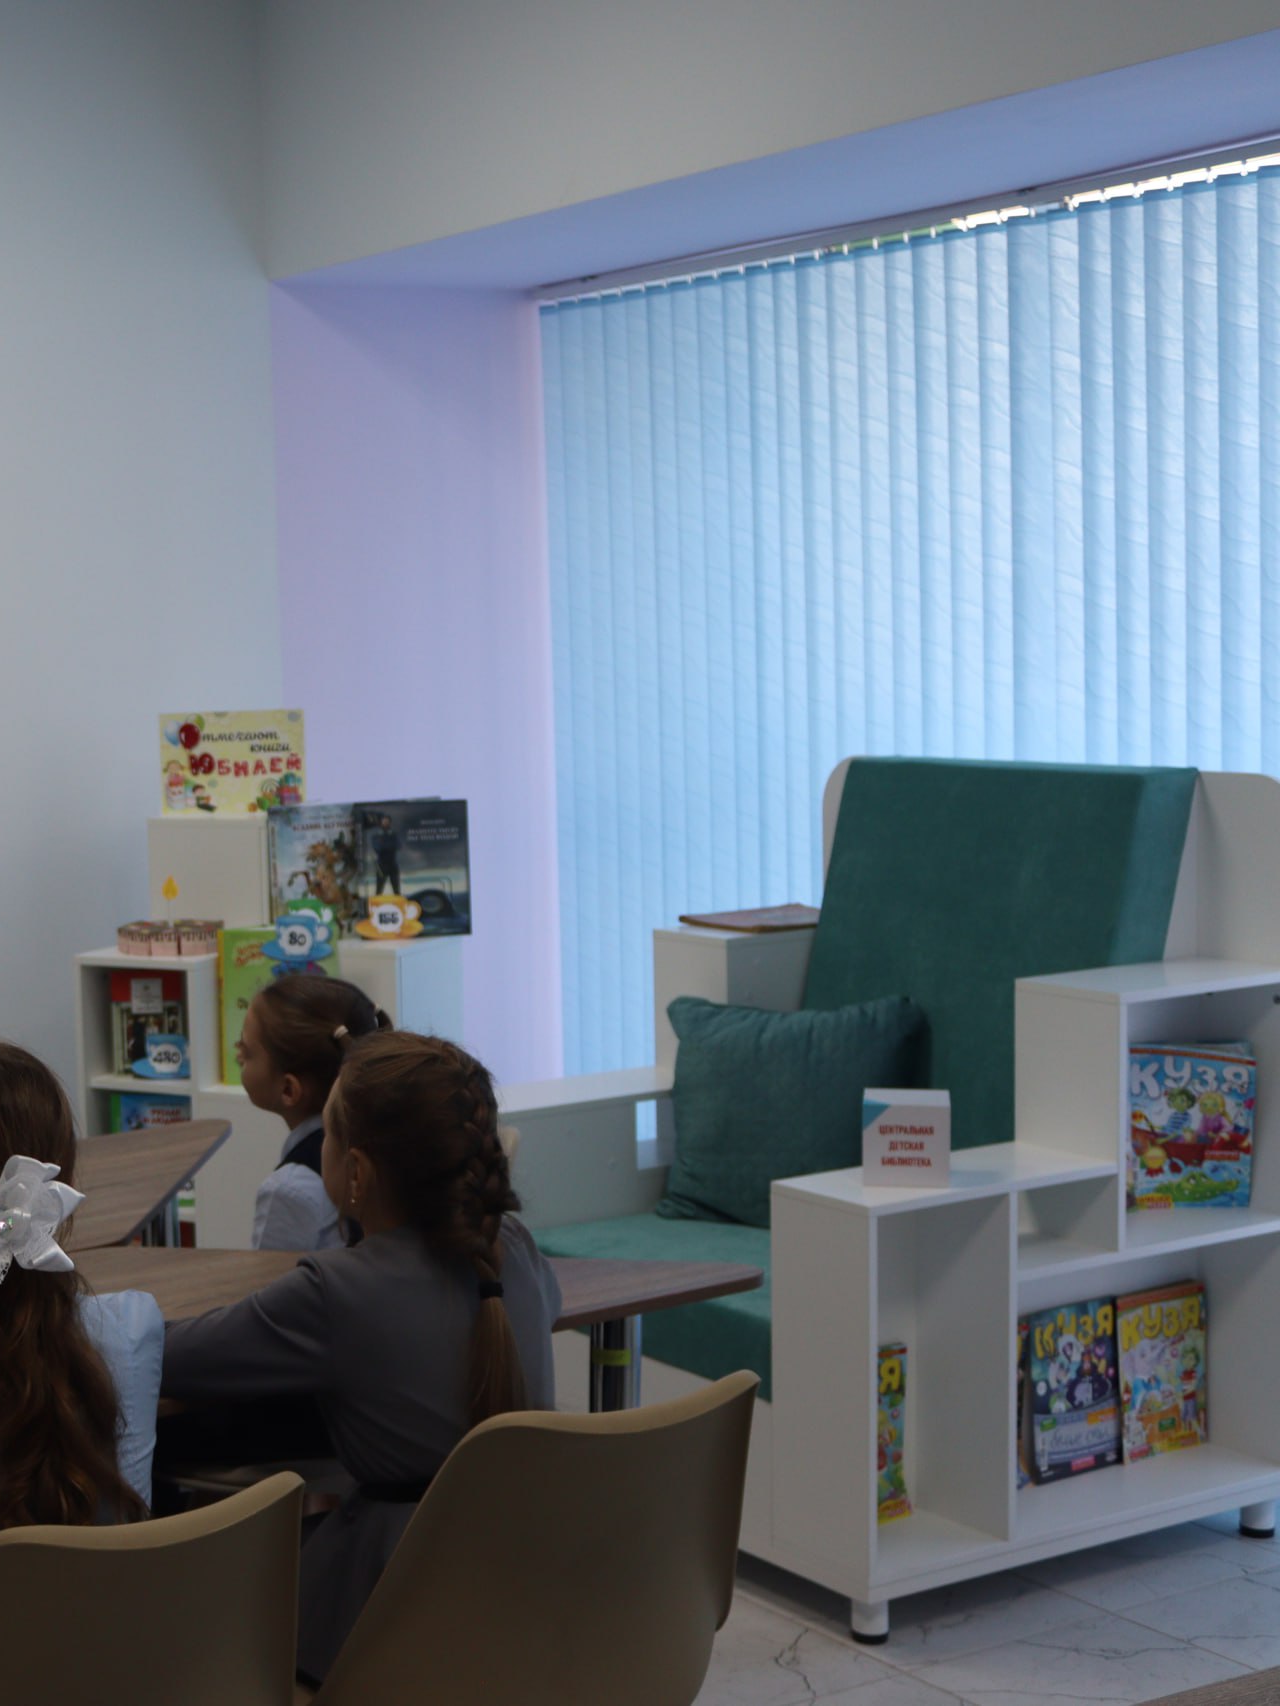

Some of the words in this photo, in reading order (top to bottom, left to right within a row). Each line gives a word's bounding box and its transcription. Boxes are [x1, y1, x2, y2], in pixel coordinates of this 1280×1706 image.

[250, 743, 291, 753] книги
[188, 752, 302, 777] ЮБИЛЕЙ
[288, 930, 308, 947] 80
[1130, 1055, 1250, 1100] КУЗЯ
[878, 1124, 935, 1136] ЦЕНТРАЛЬНАЯ
[888, 1140, 925, 1152] ДЕТСКАЯ
[881, 1156, 933, 1168] БИБЛИОТЕКА
[1034, 1304, 1114, 1360] КУЗЯ
[1122, 1296, 1201, 1352] КУЗЯ
